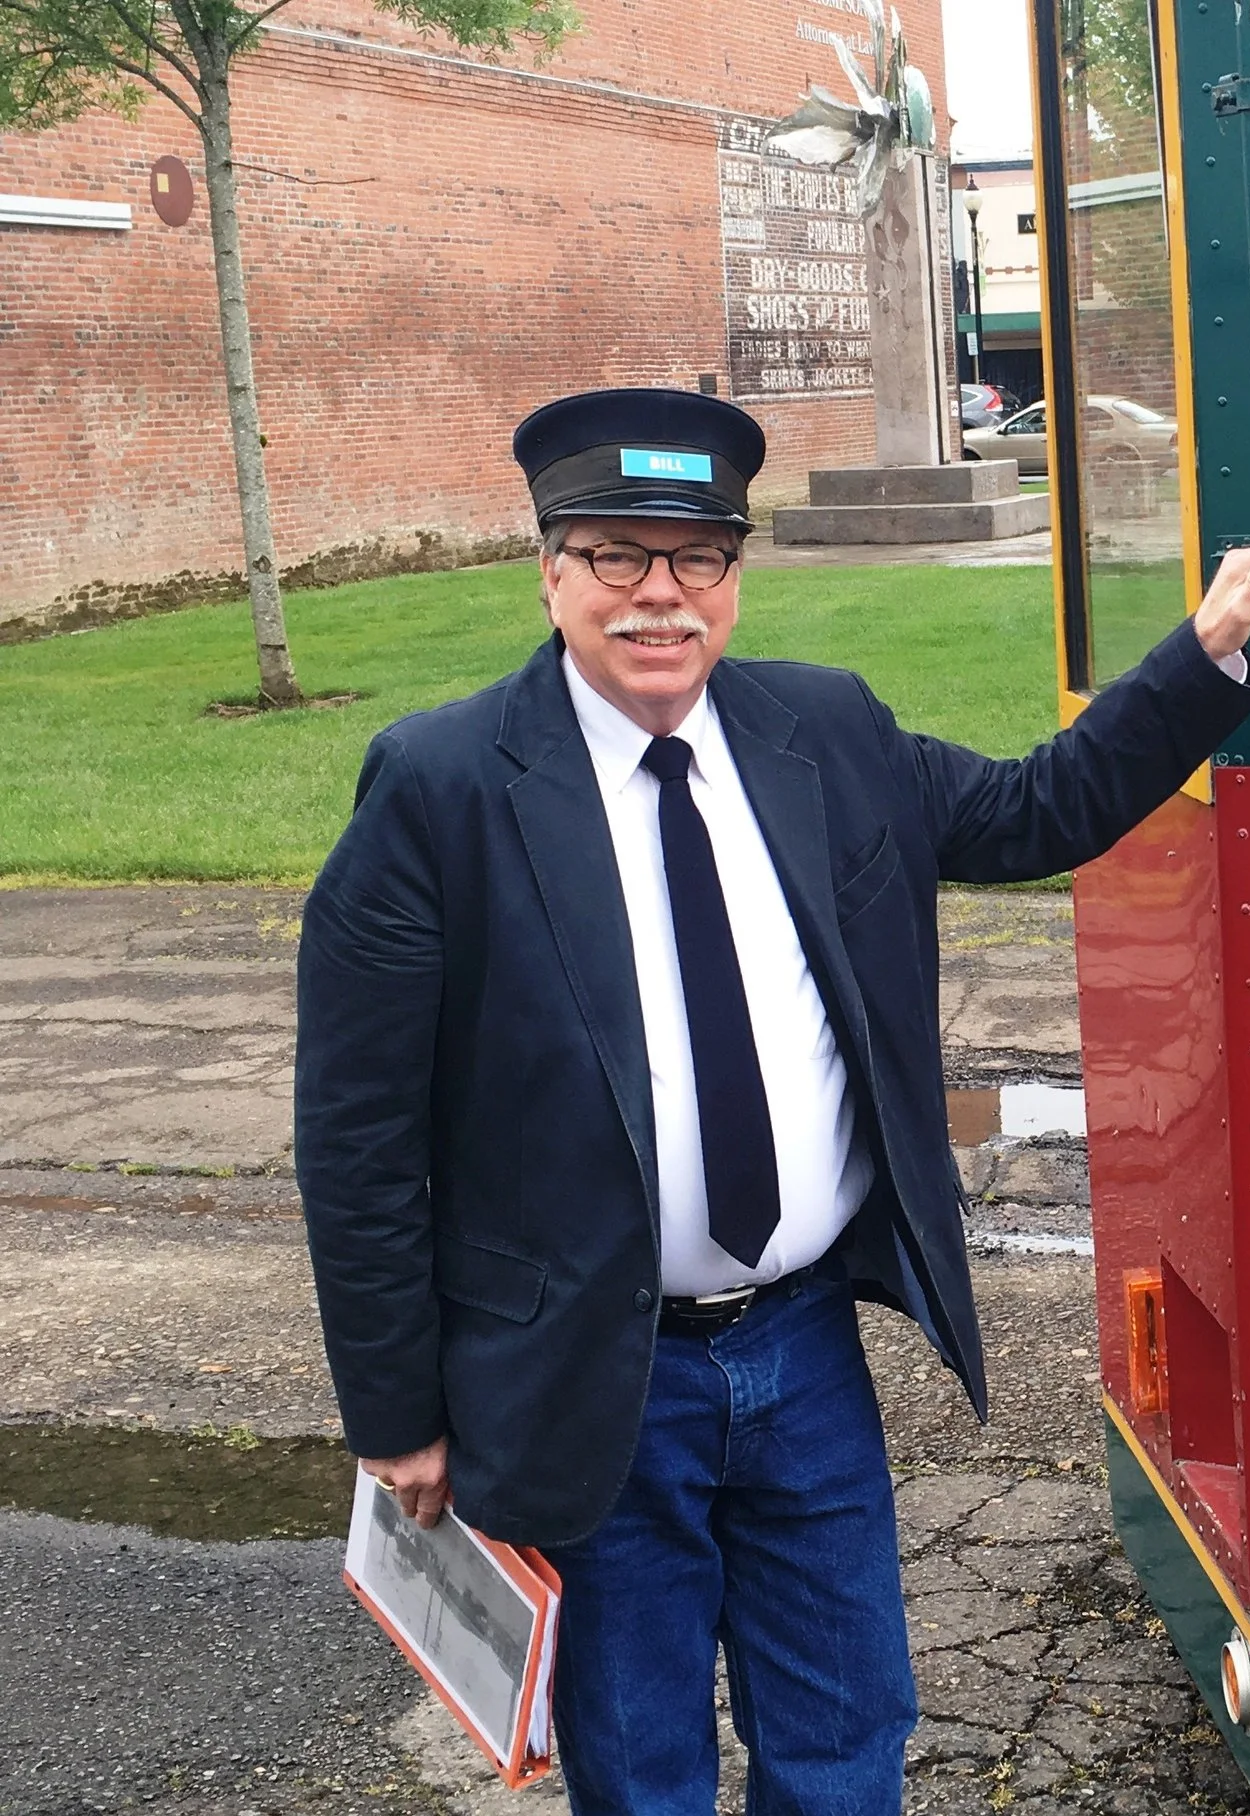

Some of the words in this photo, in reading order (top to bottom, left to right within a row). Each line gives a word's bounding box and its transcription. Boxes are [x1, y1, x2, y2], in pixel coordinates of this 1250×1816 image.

[747, 294, 809, 330] SHOES
[826, 340, 841, 359] TO
[649, 455, 685, 472] BILL
